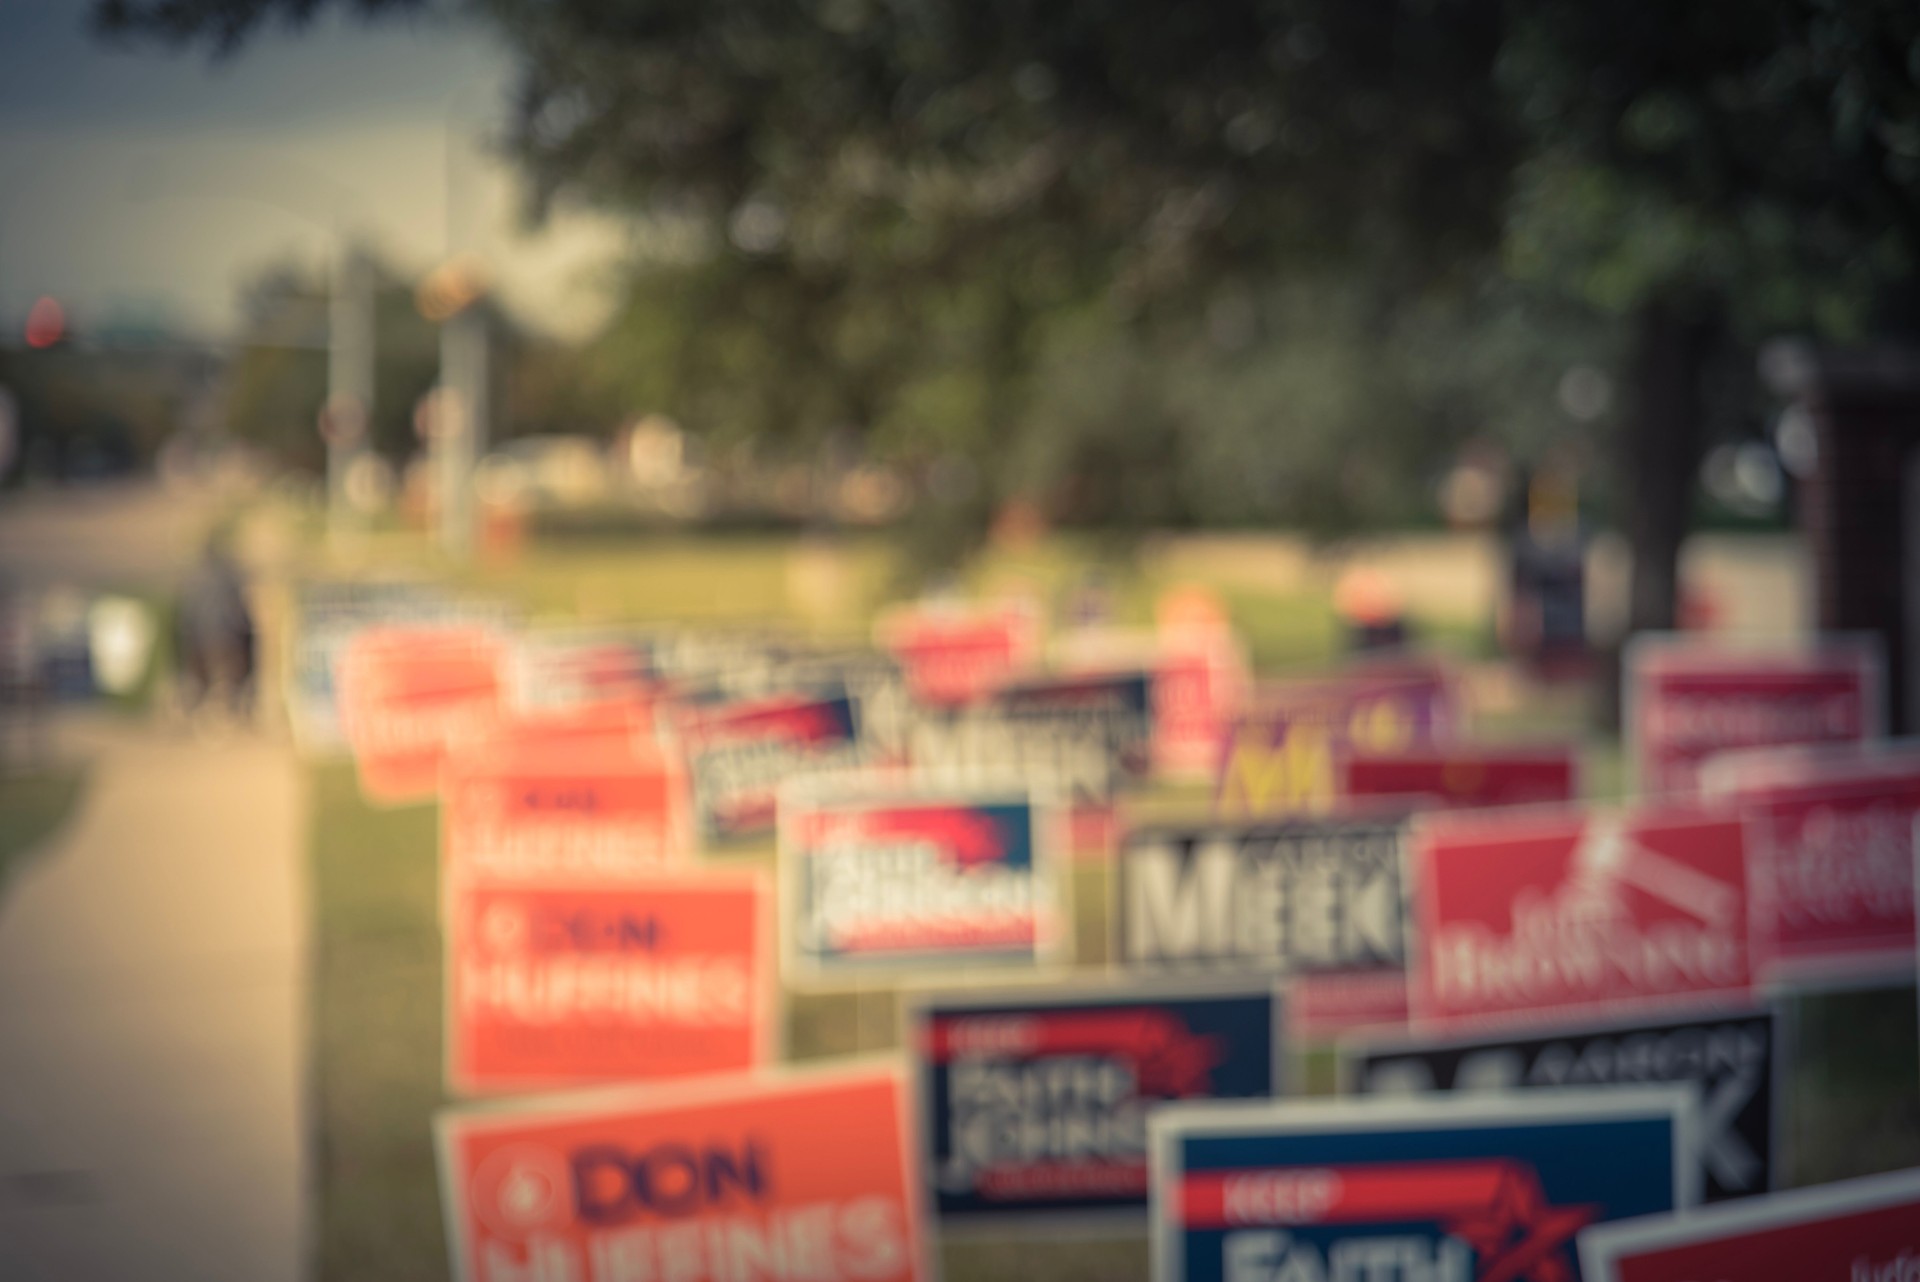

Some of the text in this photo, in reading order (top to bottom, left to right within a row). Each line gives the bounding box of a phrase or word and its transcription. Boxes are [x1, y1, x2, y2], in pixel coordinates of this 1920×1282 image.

[1127, 840, 1400, 958] MEEK
[567, 1130, 775, 1227] DON
[1222, 1168, 1340, 1224] KEEP
[476, 1194, 900, 1282] HUFFINES
[1222, 1230, 1476, 1282] FAITH
